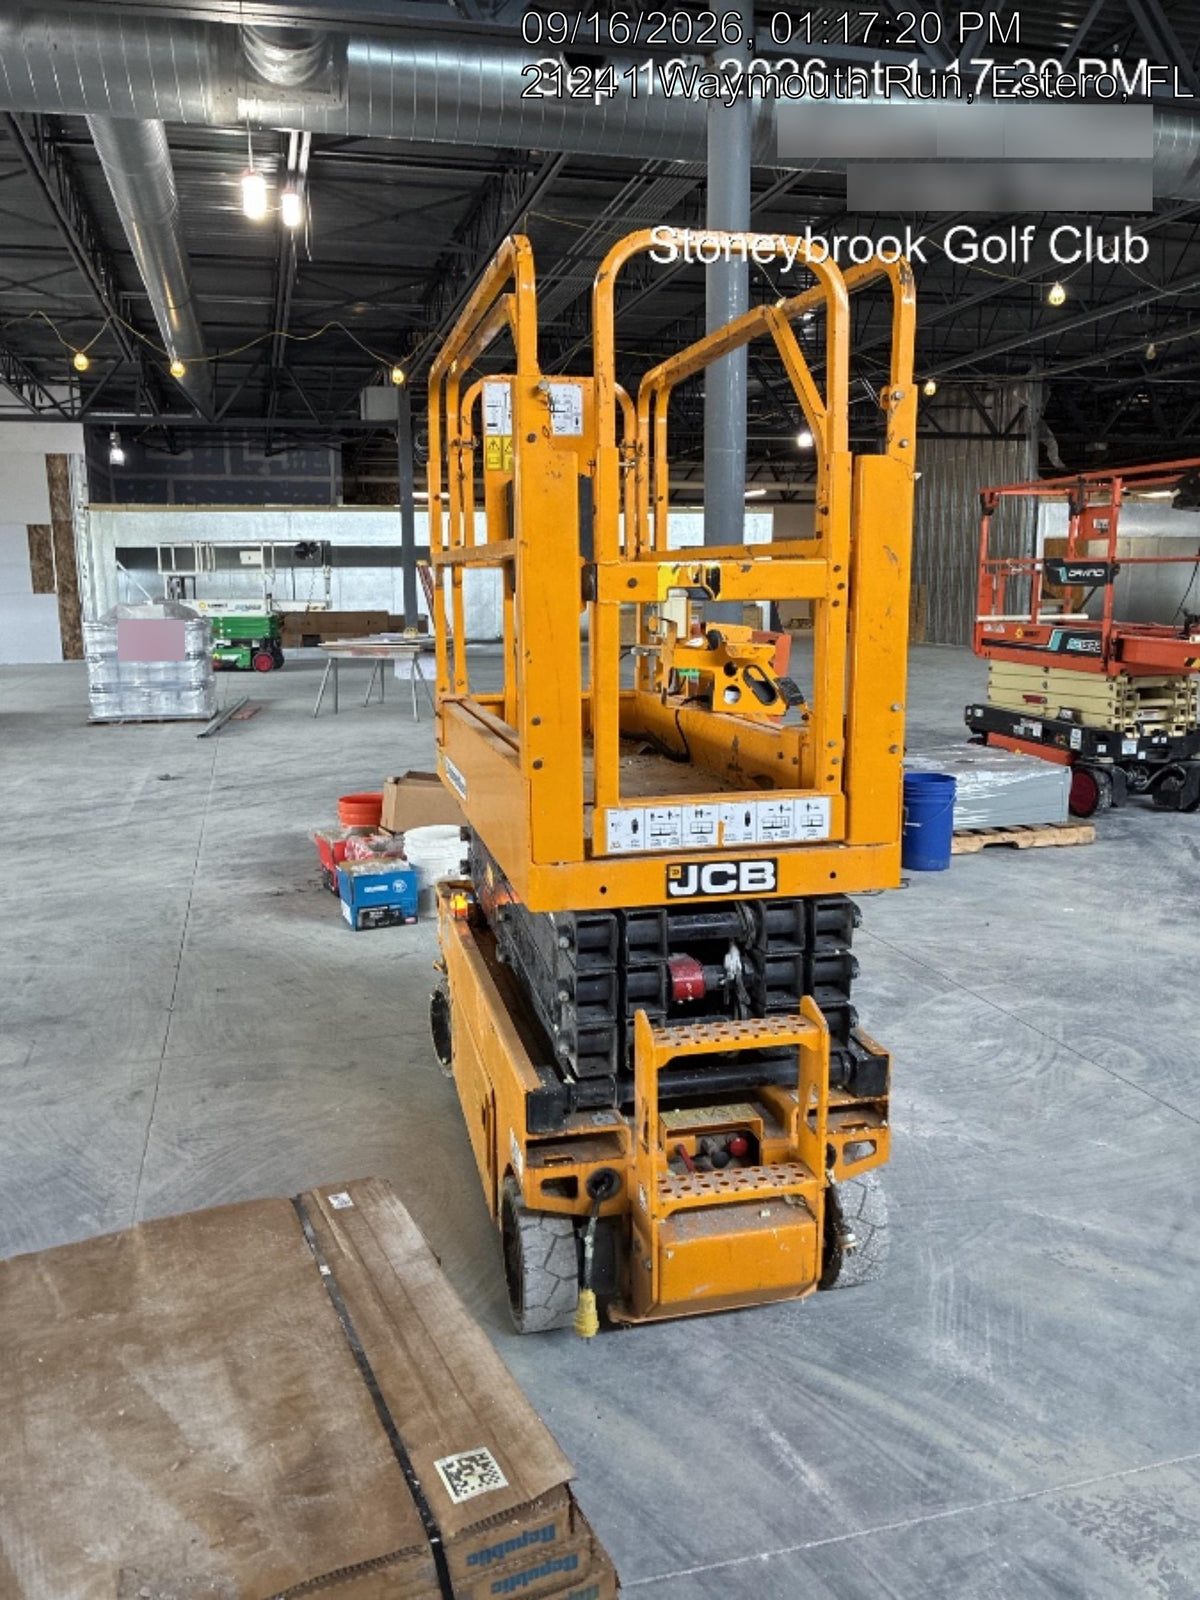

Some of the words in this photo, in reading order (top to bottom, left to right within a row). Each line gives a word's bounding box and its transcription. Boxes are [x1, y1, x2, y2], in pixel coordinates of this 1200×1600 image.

[668, 860, 776, 897] JCB
[467, 1524, 556, 1567] Republic
[490, 1553, 579, 1594] Republic
